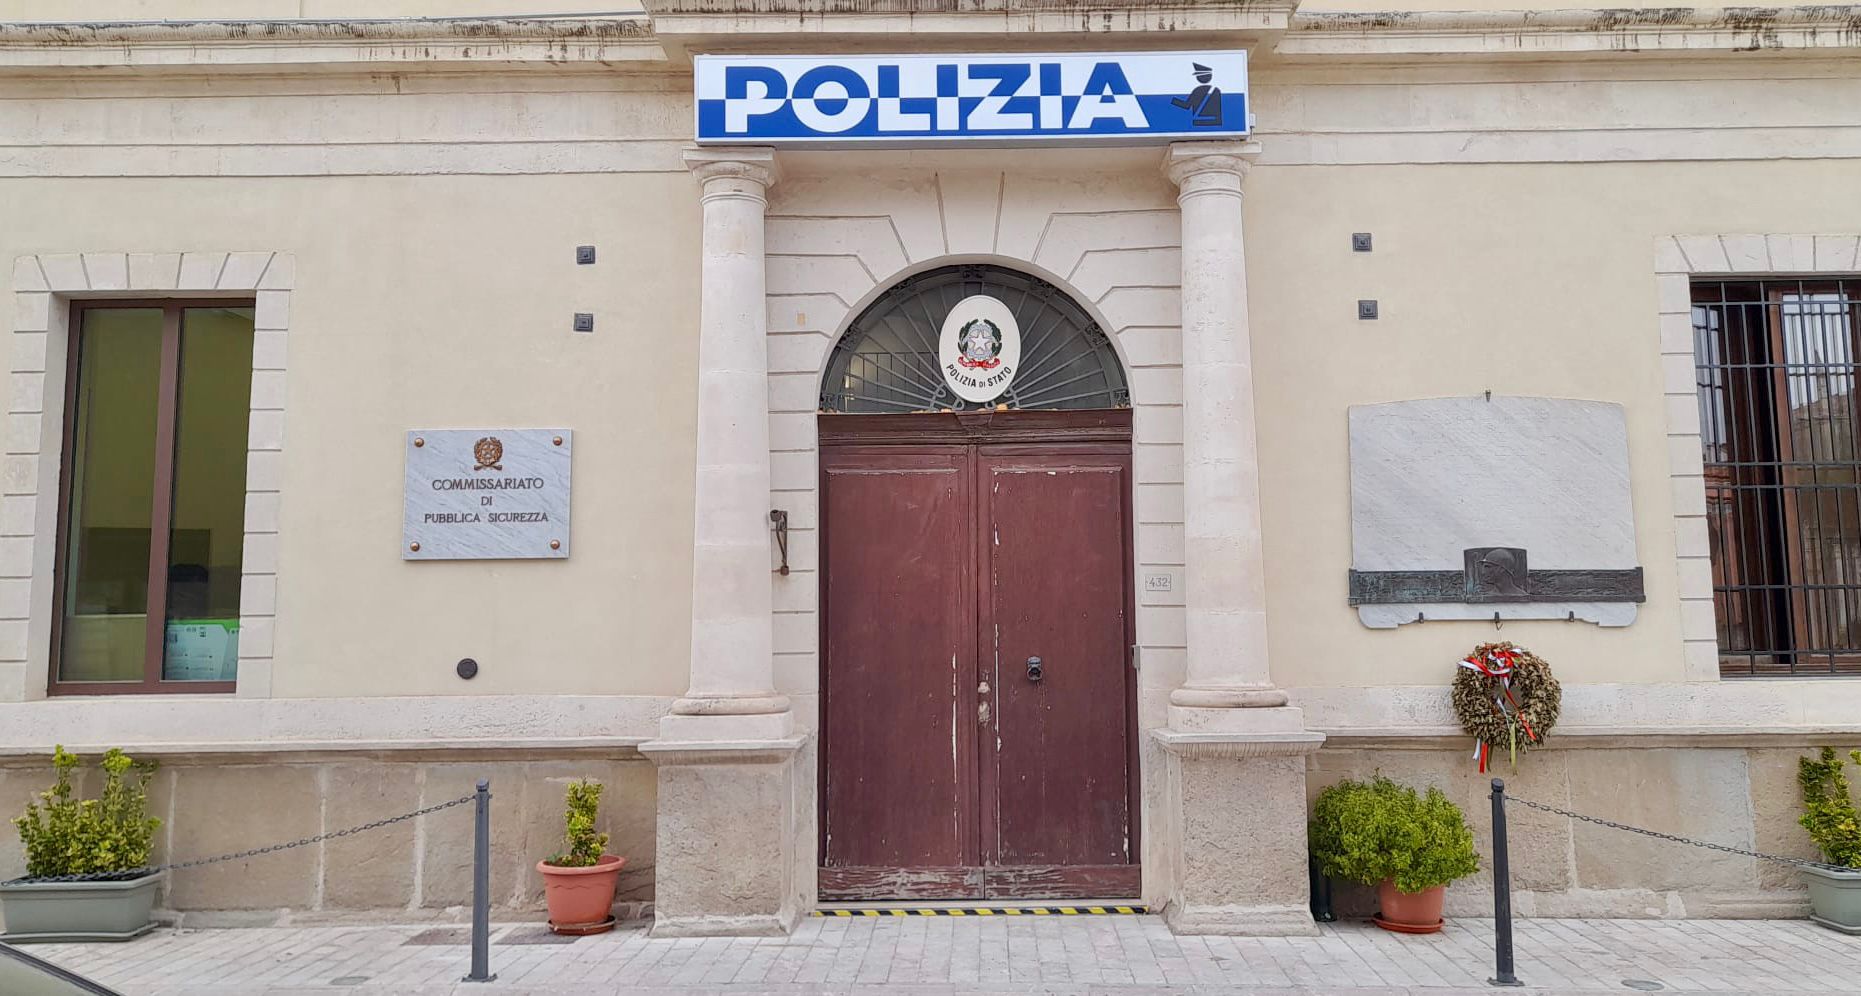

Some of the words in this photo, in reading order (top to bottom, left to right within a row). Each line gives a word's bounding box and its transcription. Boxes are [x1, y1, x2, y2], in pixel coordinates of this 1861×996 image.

[724, 61, 1150, 133] POLIZIA
[946, 364, 976, 388] POLIZIA
[988, 366, 1012, 387] STATO
[432, 478, 544, 491] COMMISSARIATO
[480, 496, 493, 506] DI
[424, 513, 481, 524] PUBBLICA
[488, 512, 549, 523] SICUREZZA
[1149, 577, 1169, 588] 432
